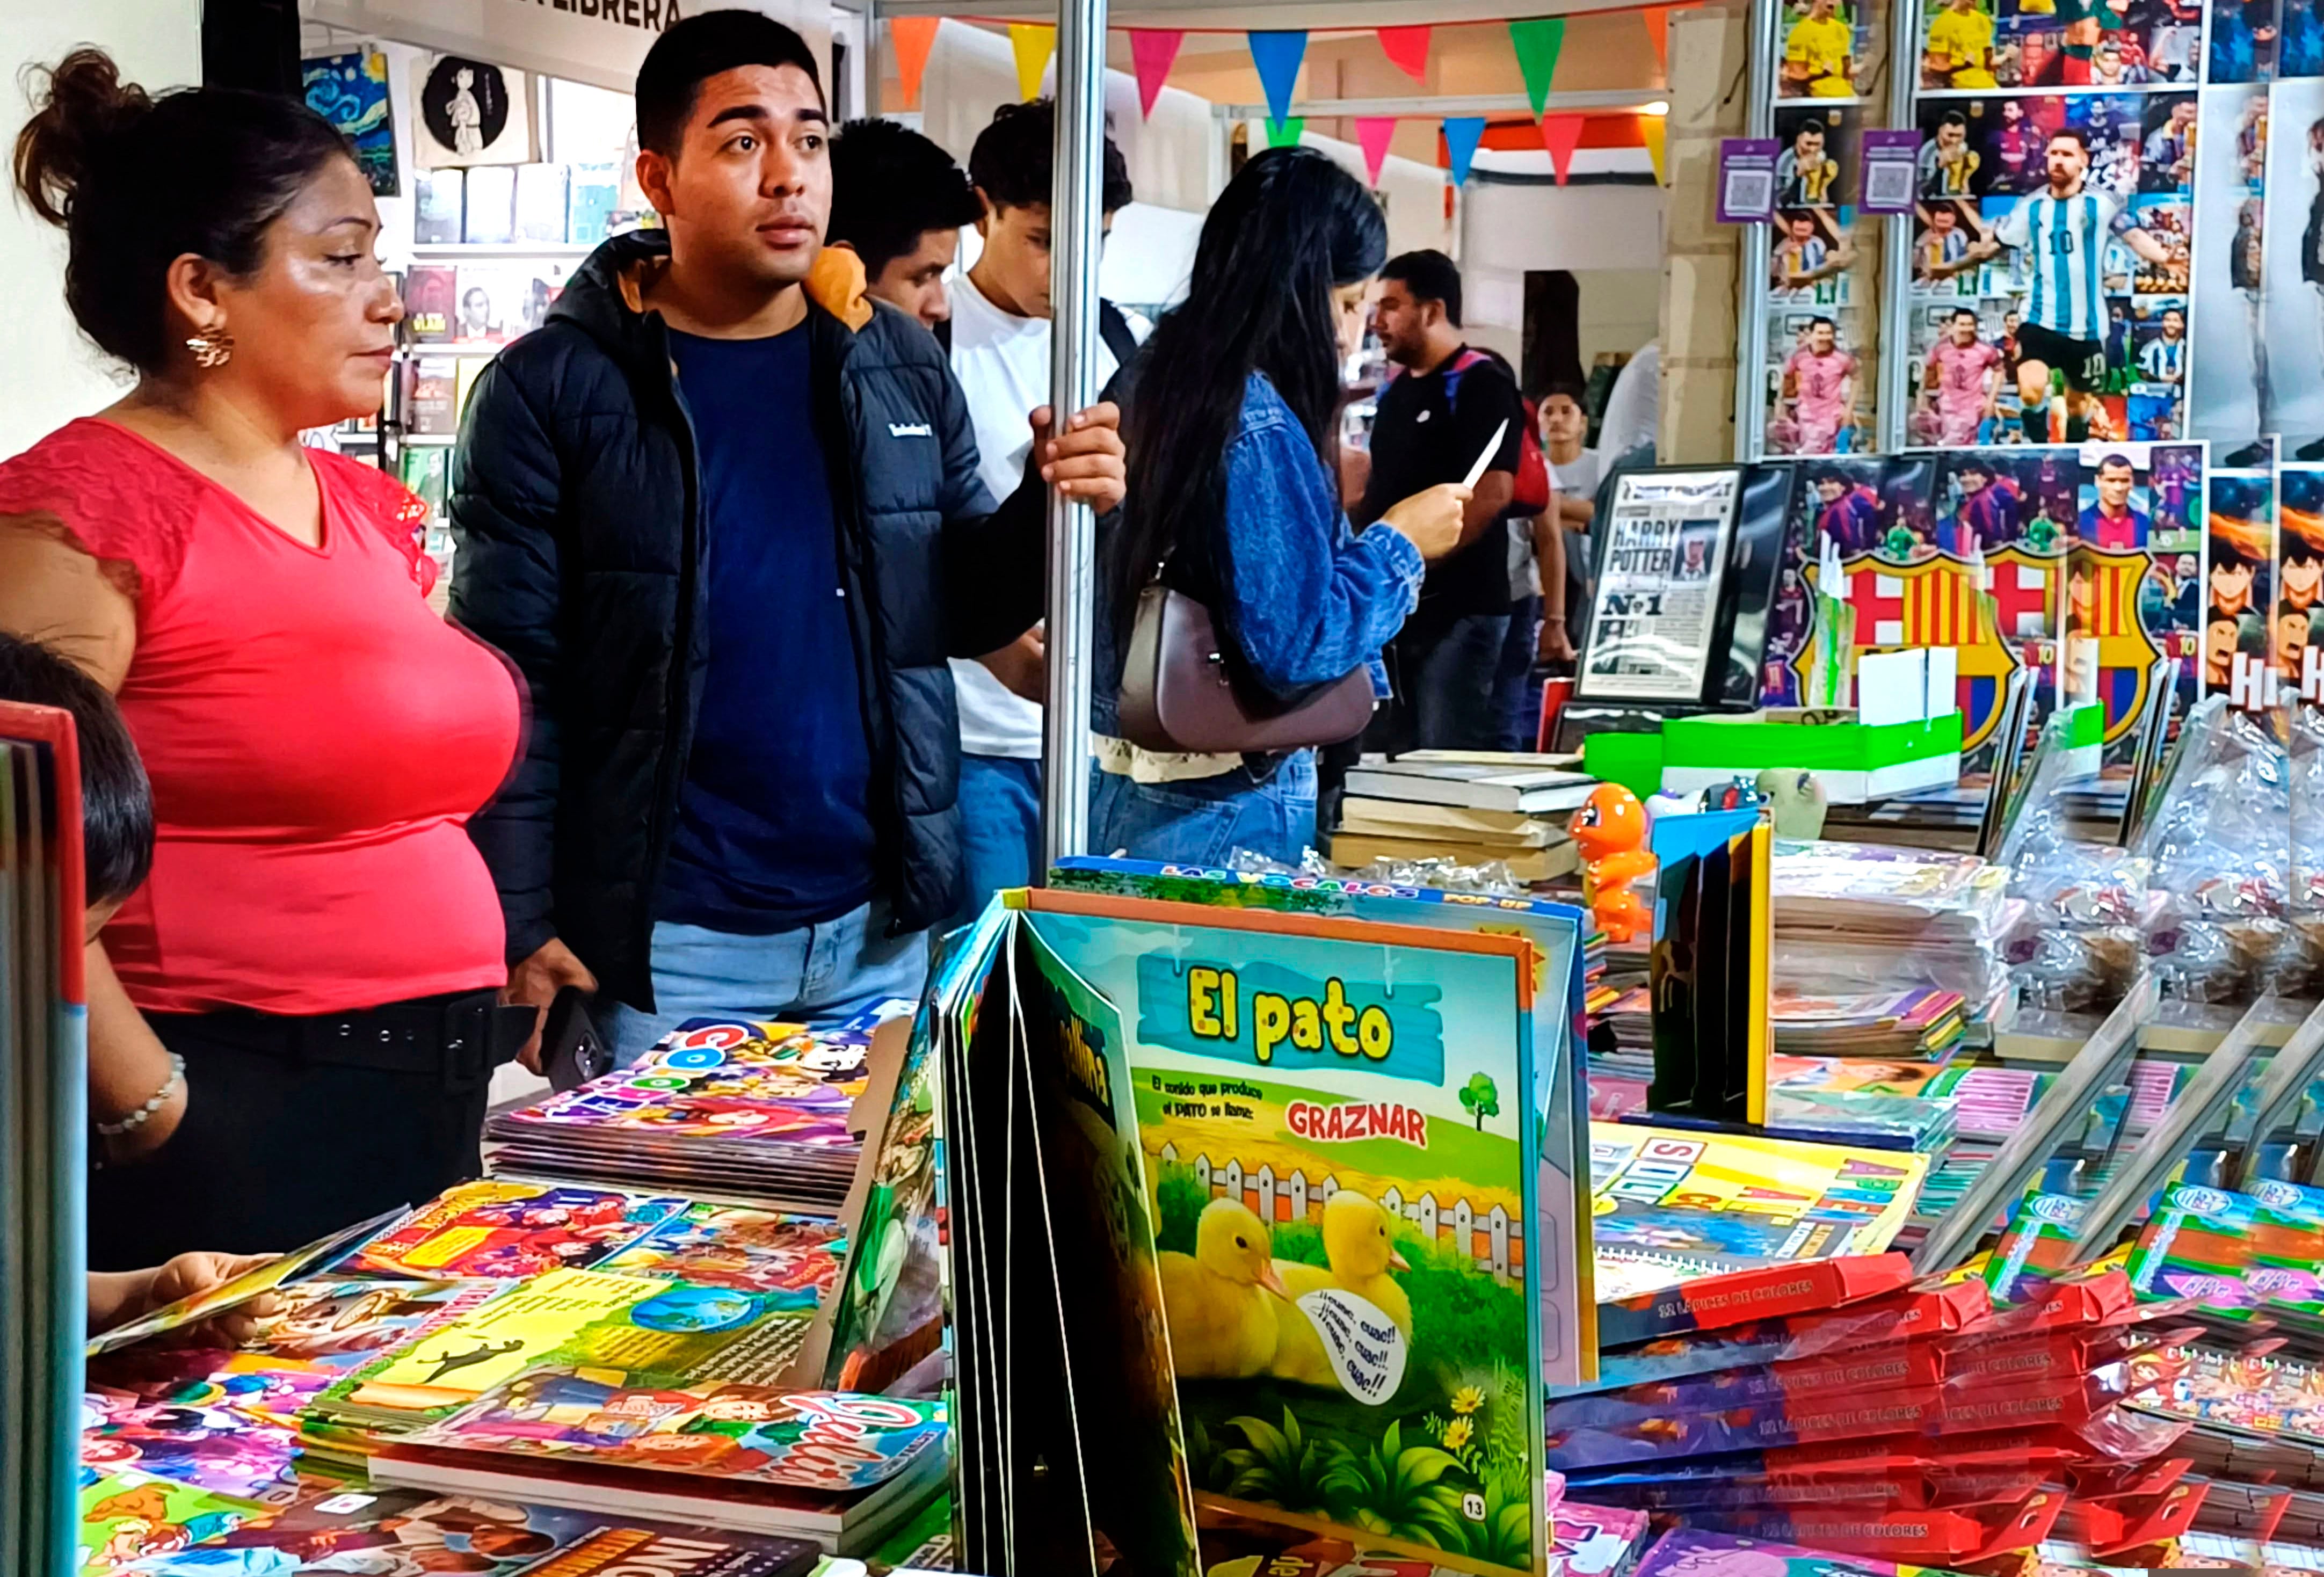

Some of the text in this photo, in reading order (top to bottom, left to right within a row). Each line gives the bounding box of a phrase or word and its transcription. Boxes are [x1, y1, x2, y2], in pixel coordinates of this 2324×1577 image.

[2049, 230, 2074, 255] 10
[2081, 353, 2105, 378] 10
[1613, 520, 1679, 547] HARRY
[1609, 549, 1674, 572] POTTER
[1160, 866, 1226, 881] LAS
[1188, 968, 1393, 1063] El pato
[1175, 1102, 1207, 1117] PATO
[1287, 1102, 1426, 1149] GRAZNAR
[1731, 1290, 1751, 1303] DE
[1753, 1280, 1814, 1301] COLORES
[1847, 1361, 1912, 1379] COLORES
[1857, 1405, 1923, 1424] COLORES
[1466, 1500, 1484, 1517] 13
[1862, 1522, 1928, 1537] COLORES
